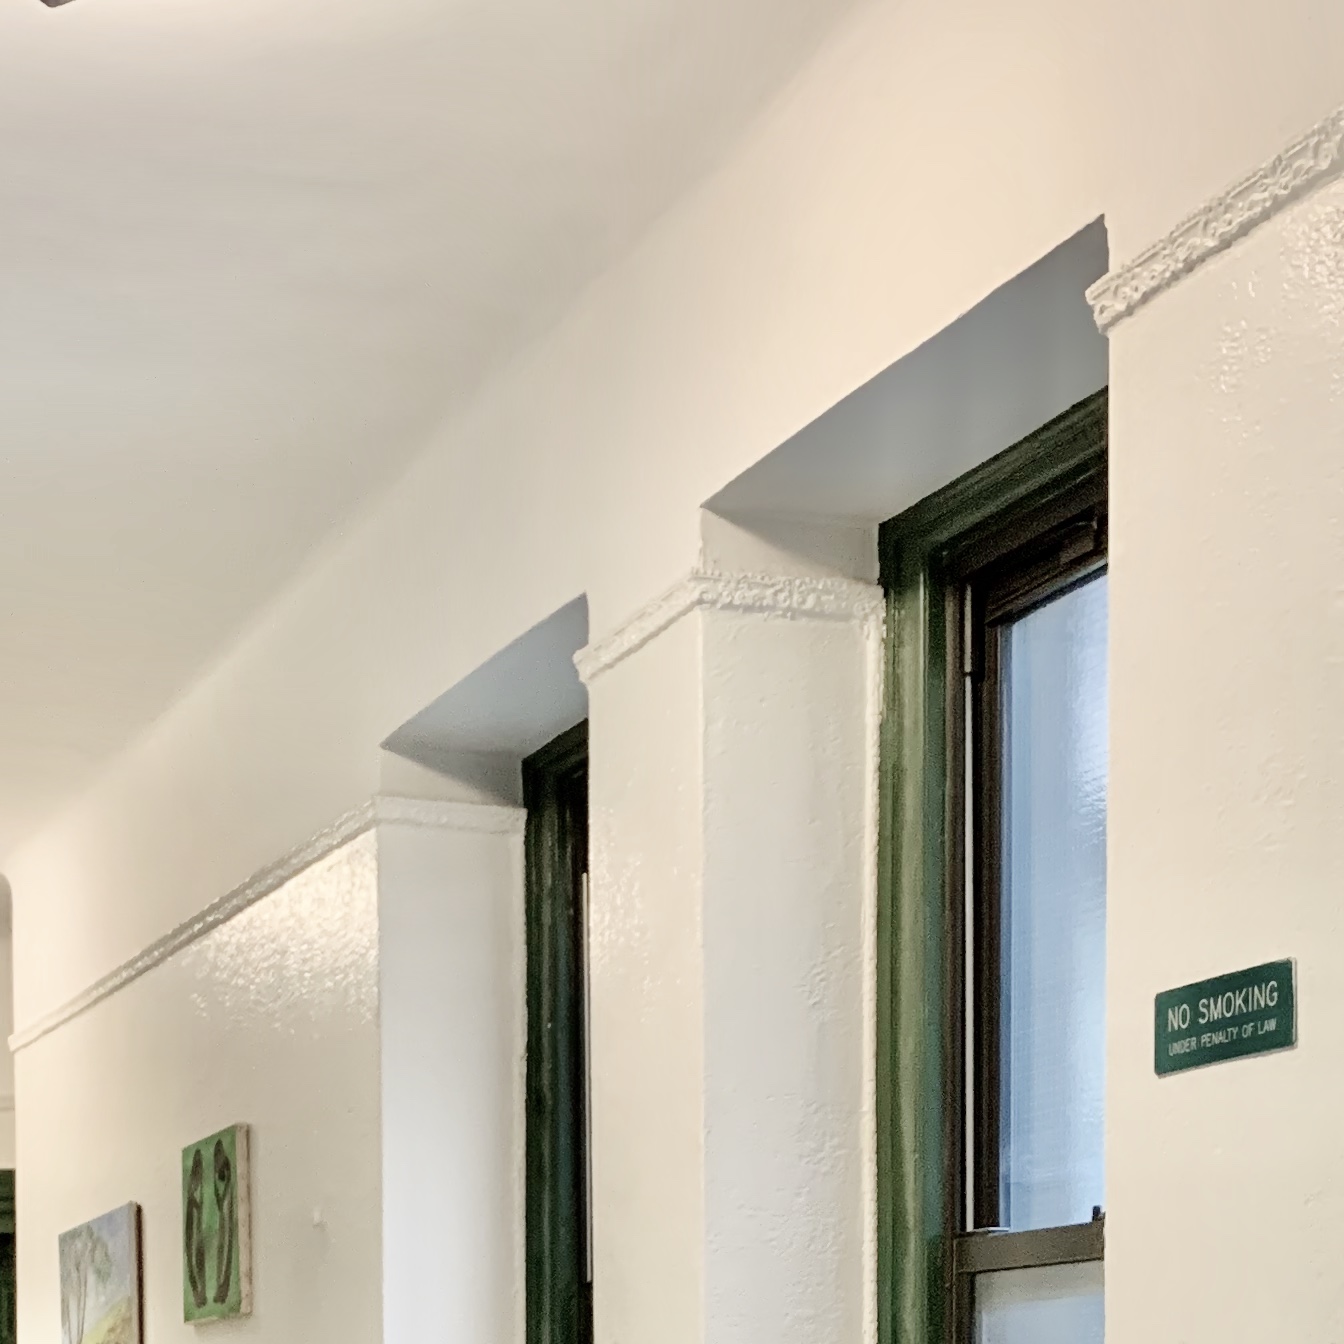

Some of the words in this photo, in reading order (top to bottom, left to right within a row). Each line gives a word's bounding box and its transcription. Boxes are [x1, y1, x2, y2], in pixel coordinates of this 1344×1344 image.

[1167, 1003, 1191, 1033] NO
[1198, 980, 1279, 1024] SMOKING
[1168, 1036, 1197, 1057] UNDER
[1200, 1026, 1239, 1048] PENALTY
[1241, 1022, 1255, 1039] OF
[1257, 1017, 1277, 1035] LAW
